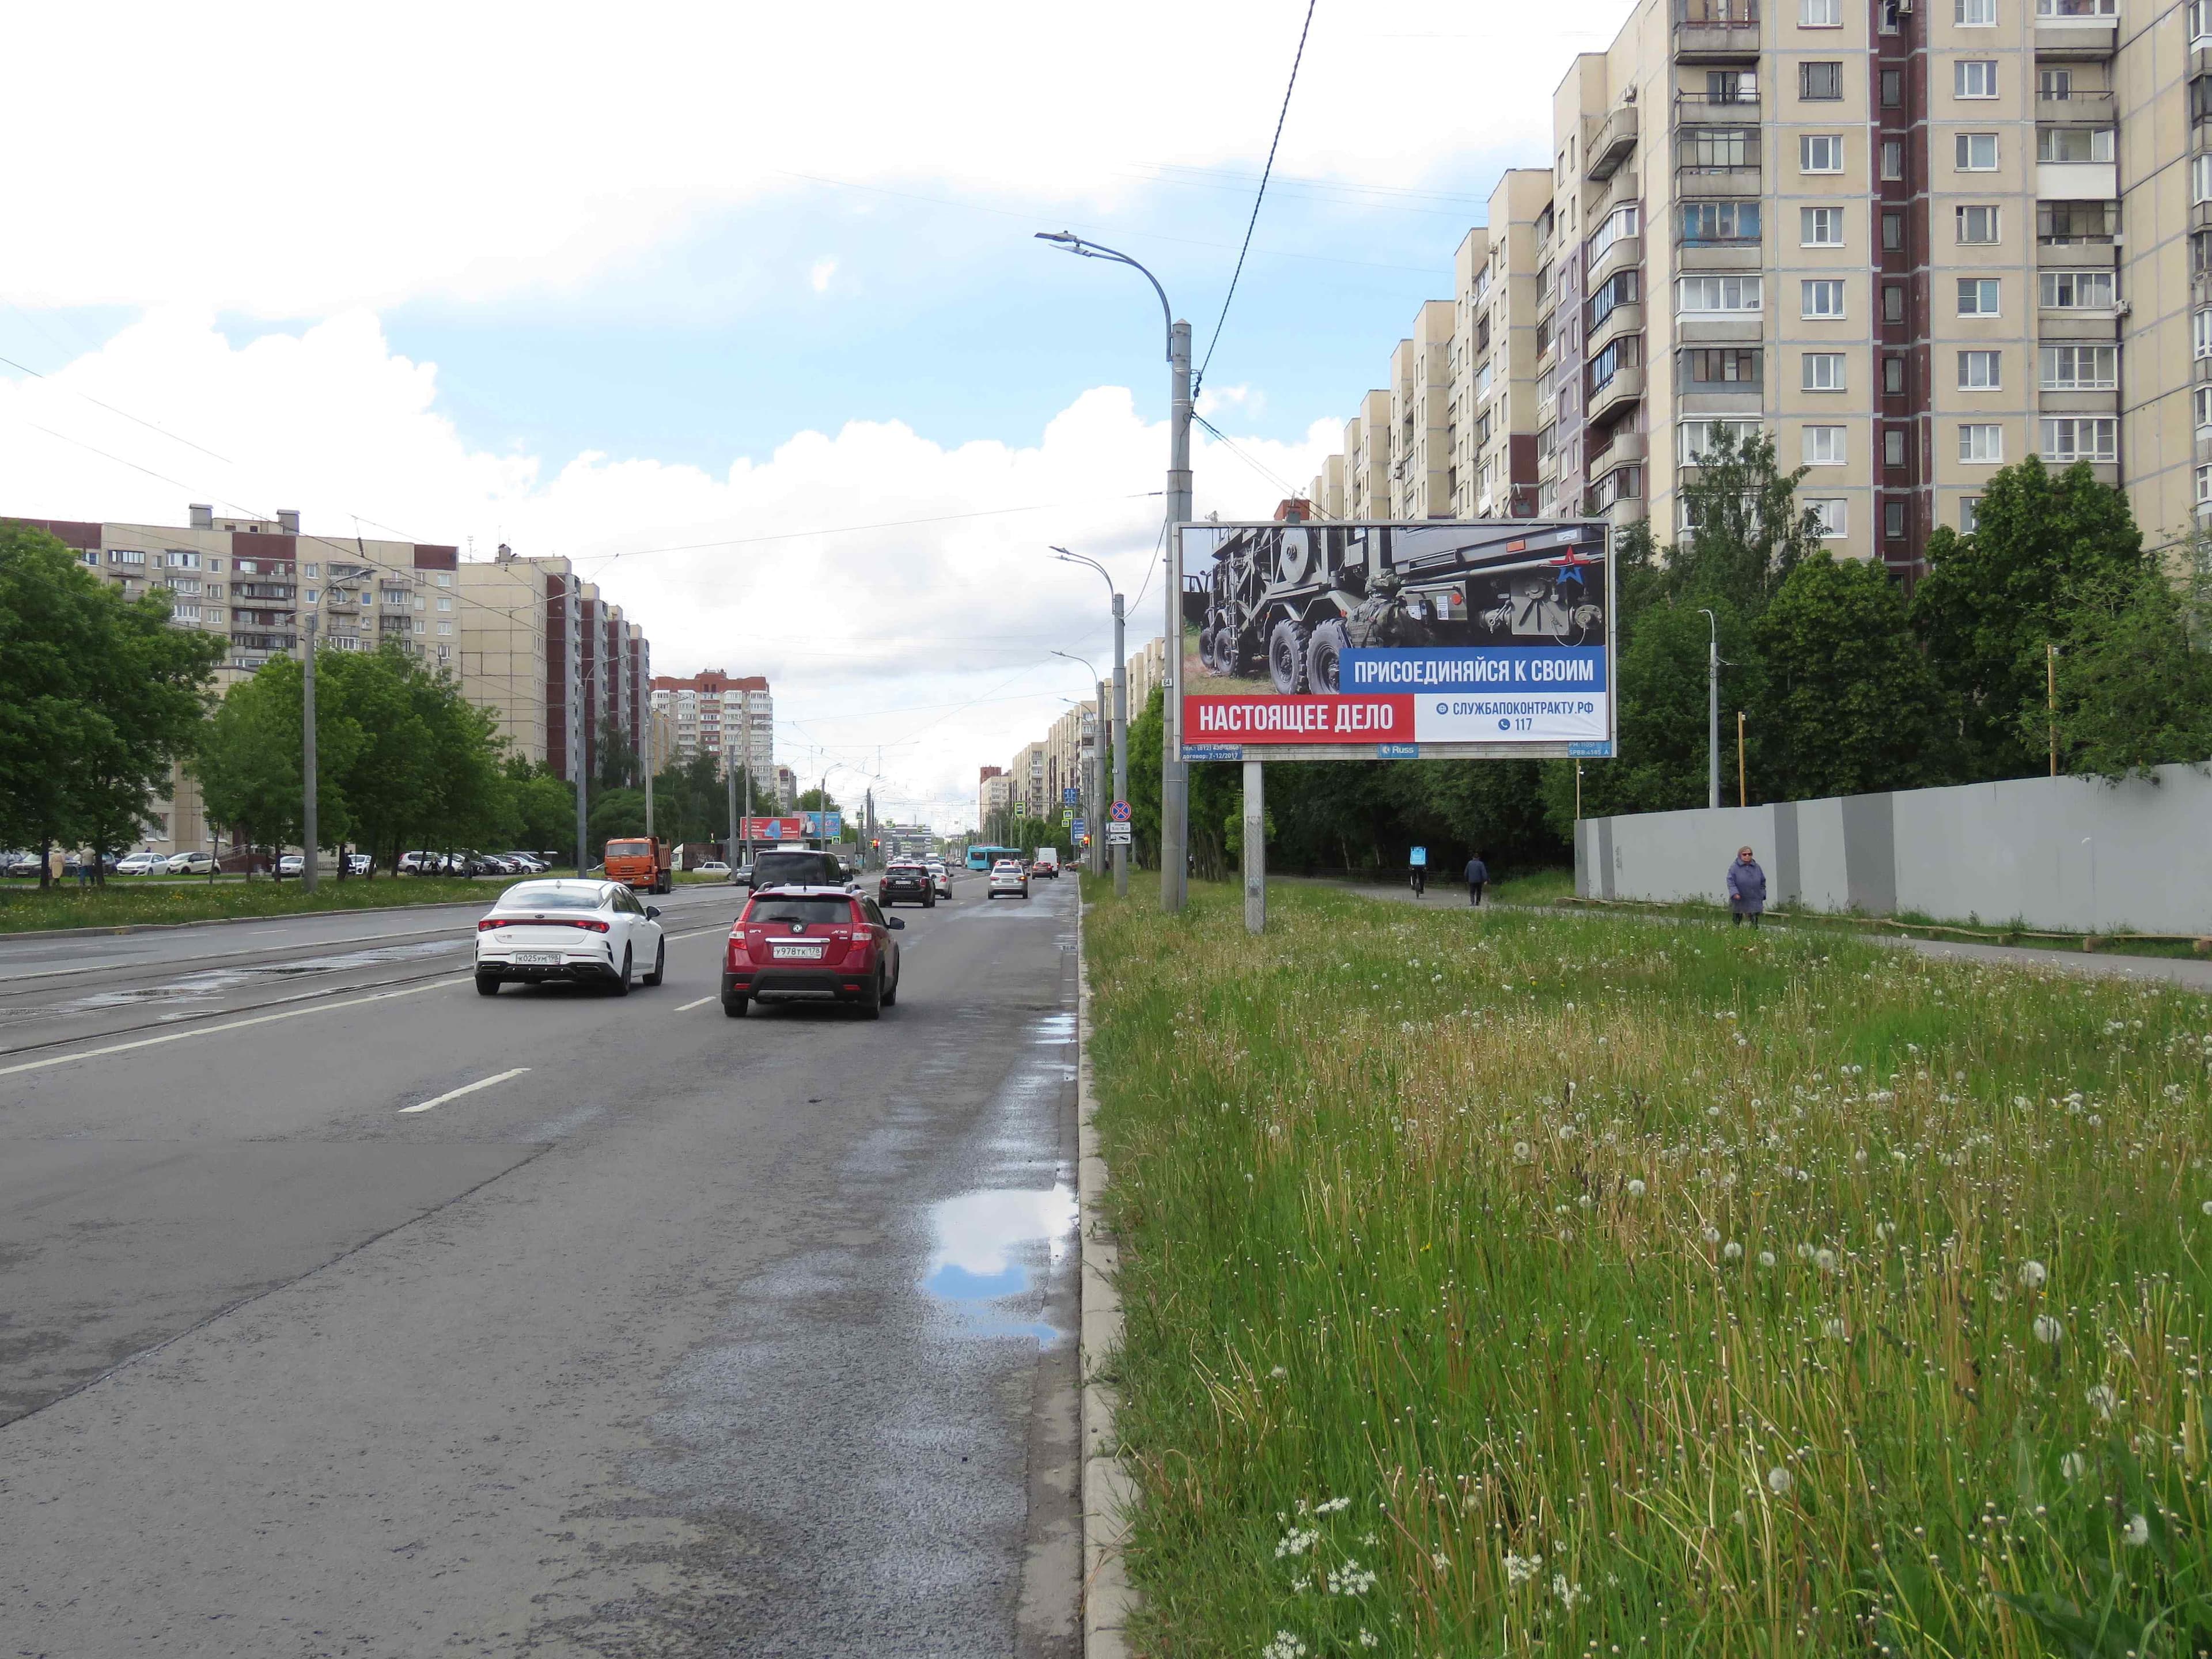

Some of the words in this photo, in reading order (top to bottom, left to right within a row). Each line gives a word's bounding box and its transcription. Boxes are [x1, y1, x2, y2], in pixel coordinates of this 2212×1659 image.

[1354, 656, 1509, 685] ПРИСОЕДИНЯЙСЯ
[1515, 660, 1527, 681] К
[1531, 659, 1593, 681] СВОИМ
[1200, 705, 1328, 733] НАСТОЯЩЕЕ
[1334, 704, 1393, 732] ДЕЛО
[1453, 702, 1594, 715] СЛУЖБАПОКОНТРАКТУ.РФ
[1515, 718, 1532, 730] 117
